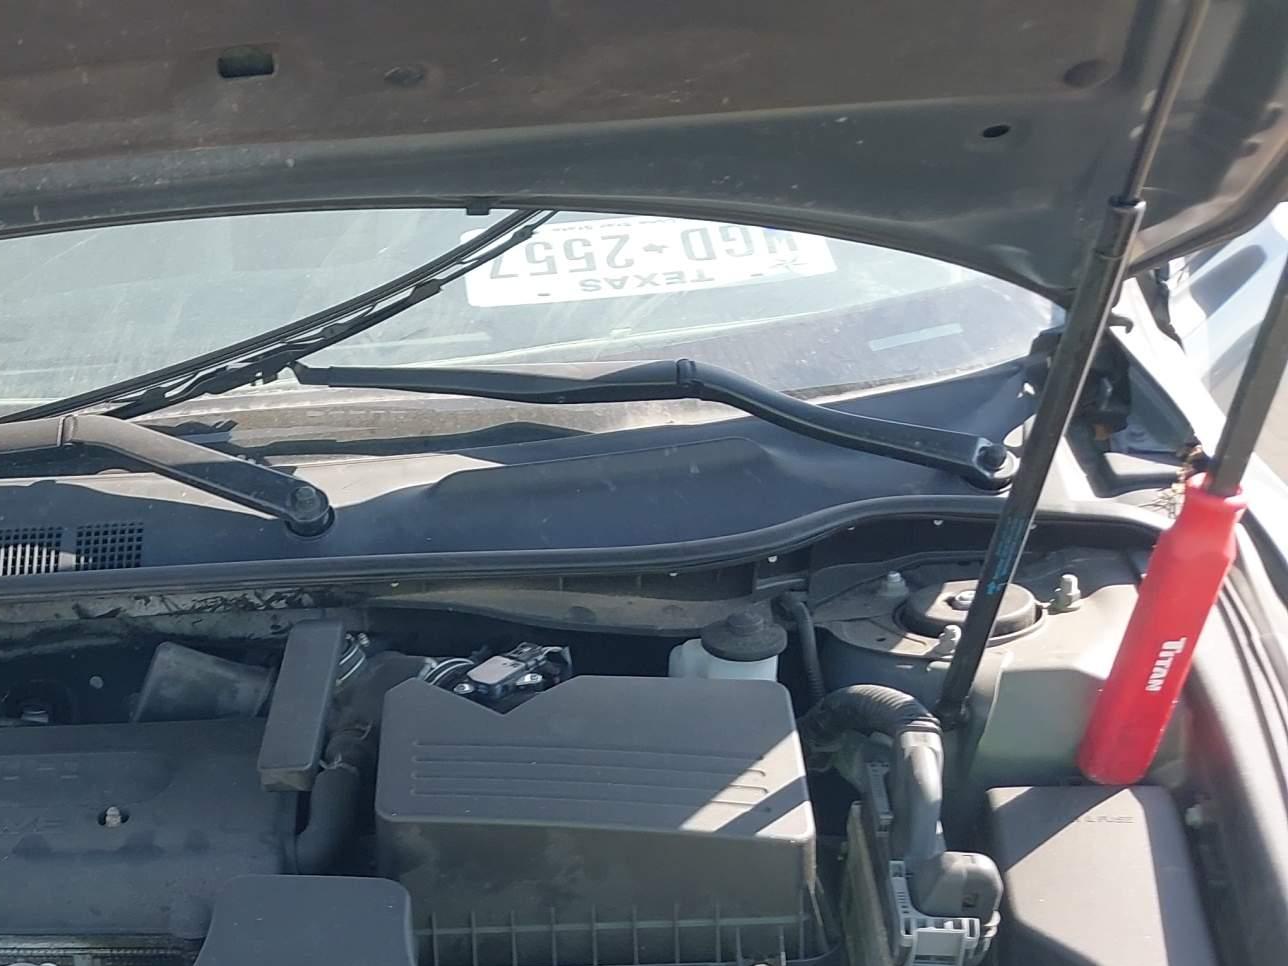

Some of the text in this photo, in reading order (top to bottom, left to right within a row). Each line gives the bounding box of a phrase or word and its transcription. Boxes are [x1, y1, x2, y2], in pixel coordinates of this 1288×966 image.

[490, 235, 634, 279] 2557
[578, 267, 715, 294] TEXAS
[1145, 637, 1187, 692] TITAN
